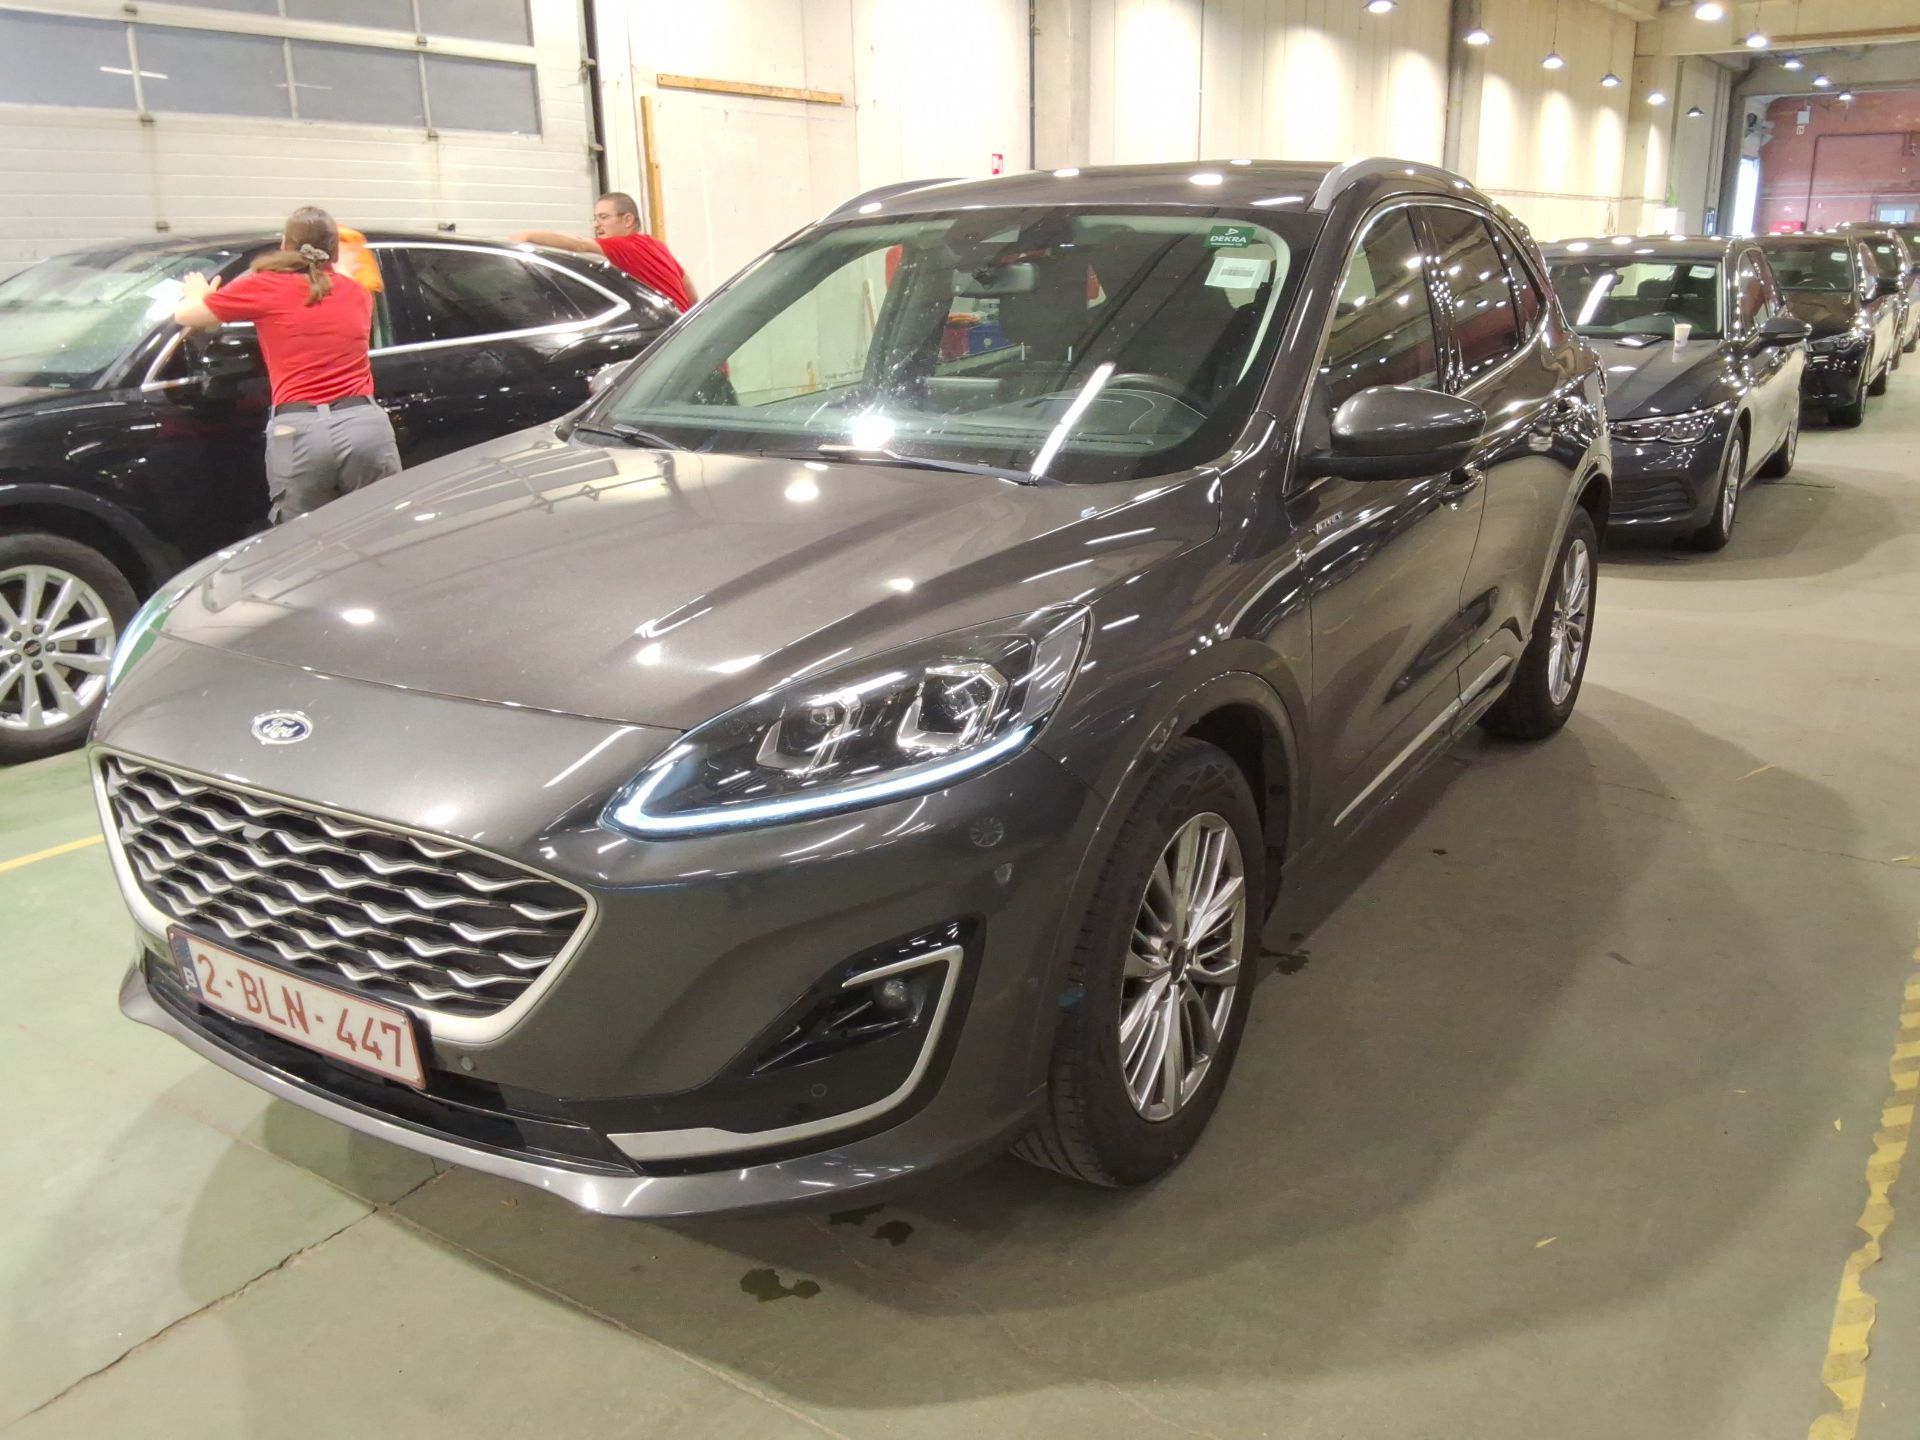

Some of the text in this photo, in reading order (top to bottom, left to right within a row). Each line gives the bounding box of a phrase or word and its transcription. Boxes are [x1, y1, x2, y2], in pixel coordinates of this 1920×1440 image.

[1209, 235, 1247, 243] DEKRA
[262, 717, 301, 739] Ford
[182, 966, 198, 988] B
[197, 953, 403, 1068] 2-BLN-447
